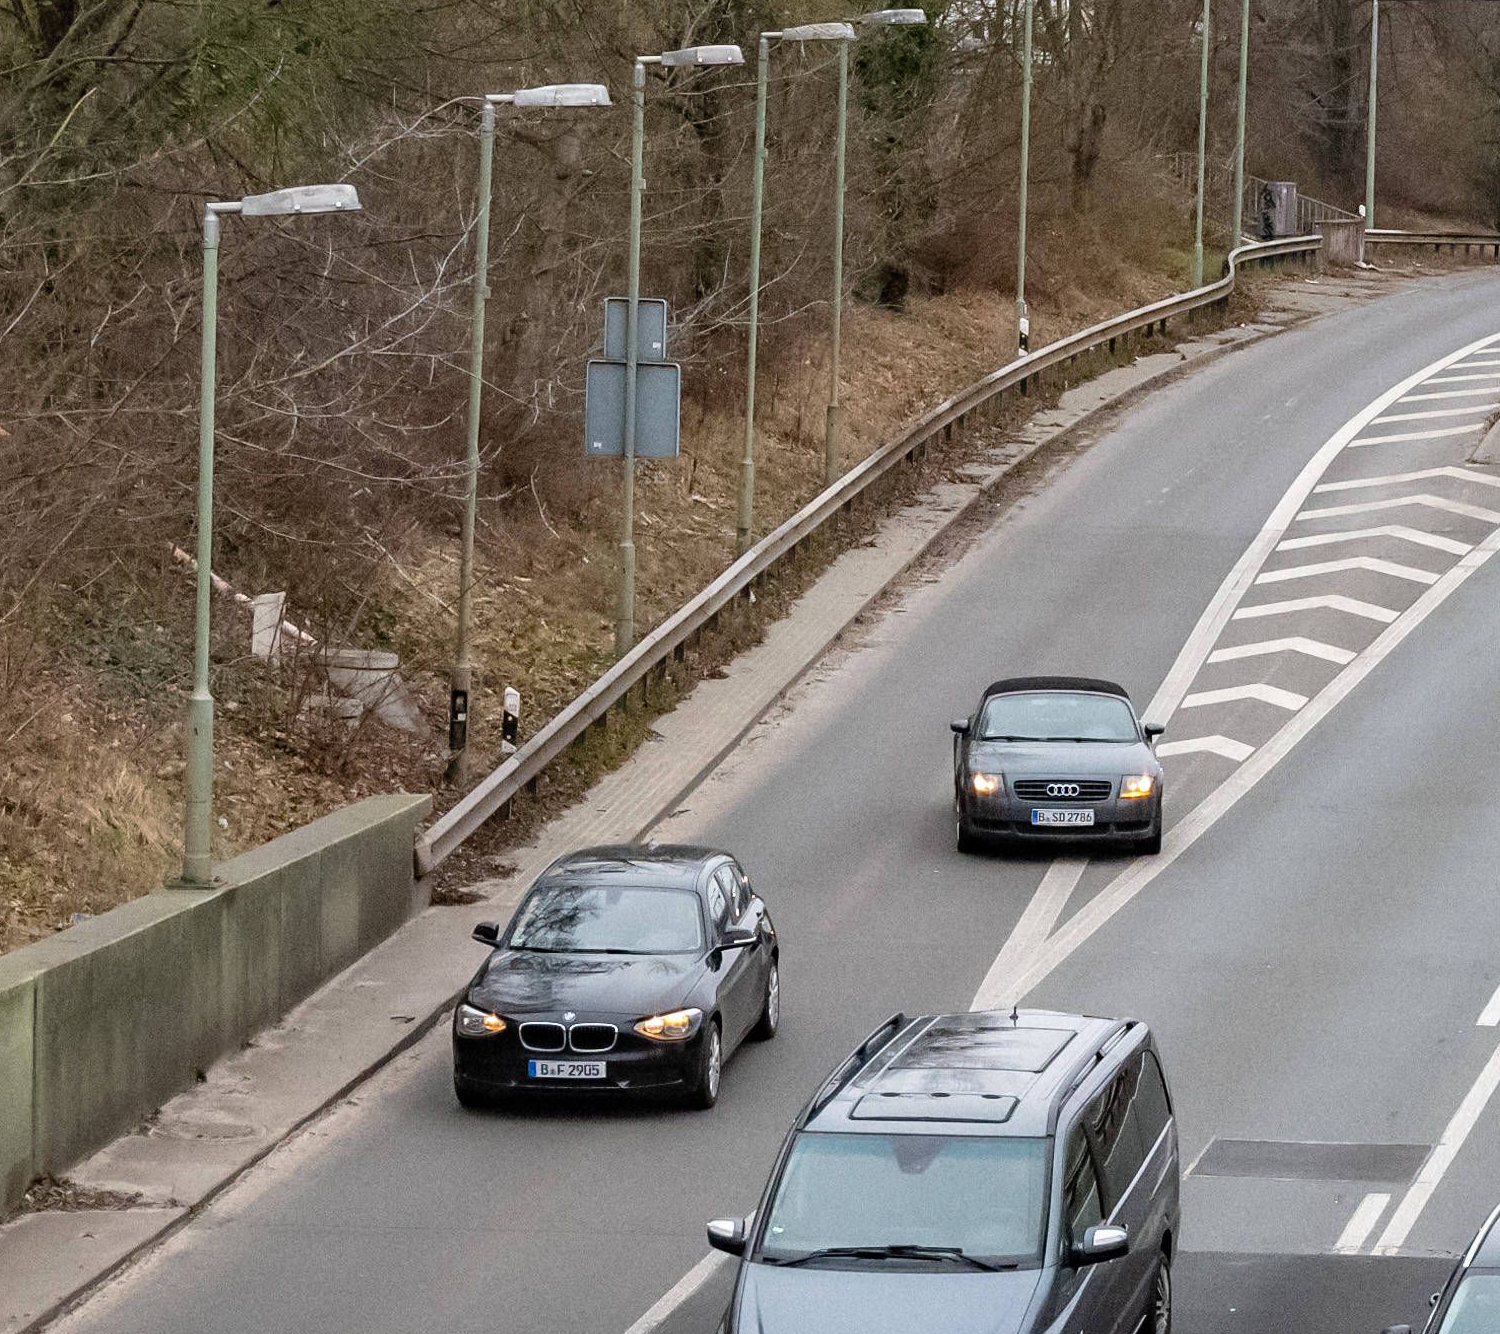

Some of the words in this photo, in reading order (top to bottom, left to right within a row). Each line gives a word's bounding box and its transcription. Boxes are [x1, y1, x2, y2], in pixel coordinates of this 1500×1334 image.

[1038, 812, 1045, 822] B
[1052, 812, 1065, 822] SD
[1067, 812, 1092, 822] 2786
[540, 1063, 549, 1076] B
[557, 1064, 566, 1076] F
[568, 1064, 600, 1076] 2905
